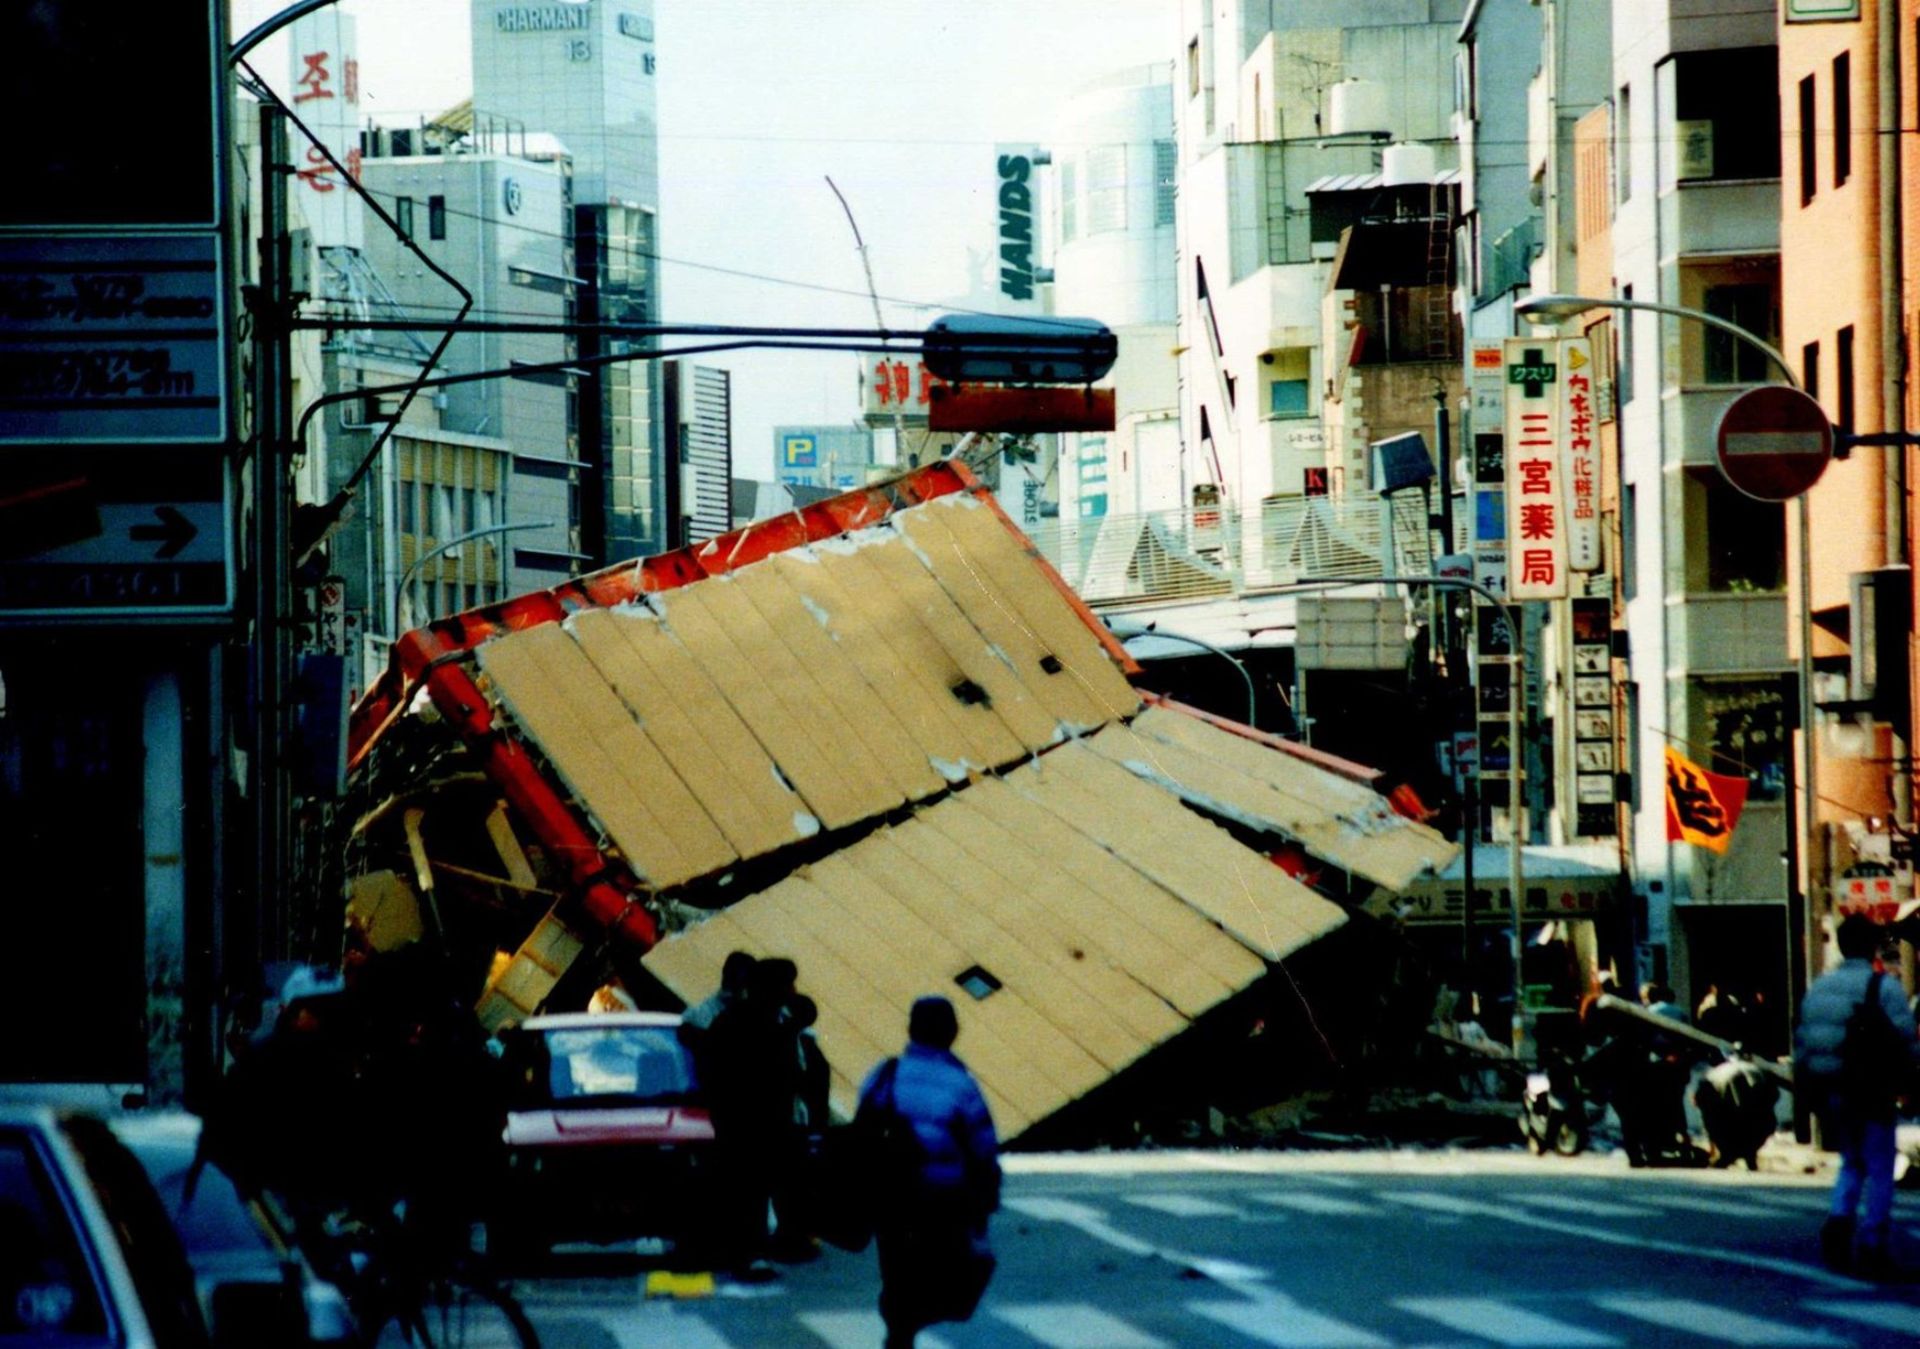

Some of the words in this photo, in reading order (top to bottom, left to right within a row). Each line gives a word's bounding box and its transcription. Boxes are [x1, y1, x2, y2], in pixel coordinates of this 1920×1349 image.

[496, 6, 591, 31] CHARMANT
[567, 40, 592, 62] 13
[998, 154, 1034, 300] HANDS
[1514, 366, 1553, 381] クスリ
[786, 439, 813, 465] P
[1023, 479, 1037, 525] STORE
[1518, 413, 1555, 587] 三宮薬局
